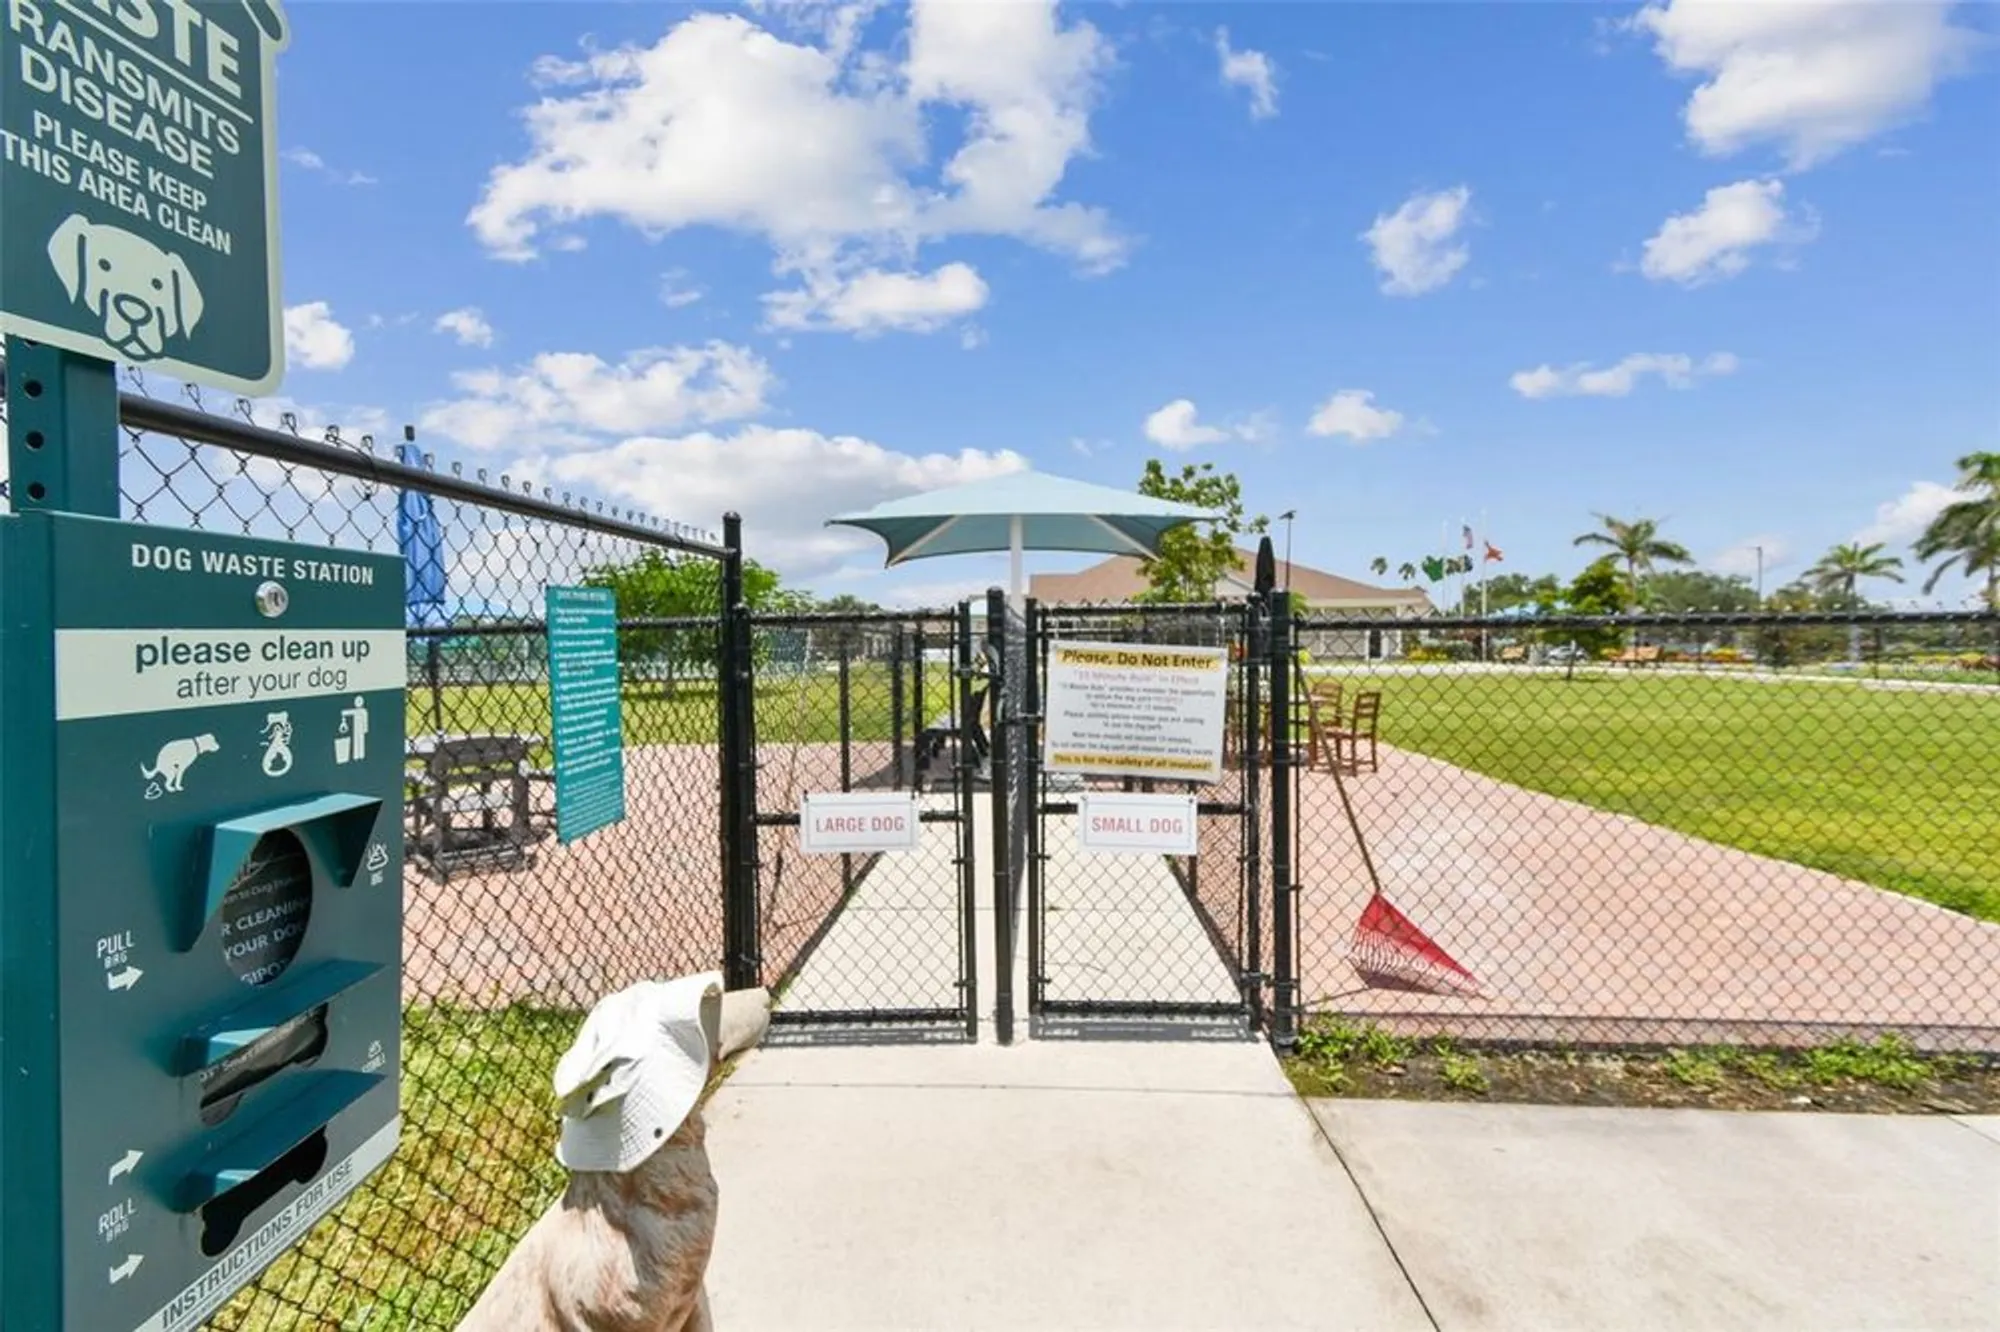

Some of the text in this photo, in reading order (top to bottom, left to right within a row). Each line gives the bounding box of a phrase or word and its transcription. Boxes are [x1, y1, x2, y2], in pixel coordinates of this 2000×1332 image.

[20, 43, 214, 179] DISEASE
[33, 110, 207, 212] PLEASE KEEP
[0, 129, 231, 255] THIS AREA CLEAN
[131, 544, 373, 585] DOG WASTE STATION
[136, 636, 370, 673] please clean up
[1118, 652, 1138, 665] Do
[1143, 654, 1171, 667] Not
[1174, 655, 1211, 669] Enter
[176, 666, 347, 699] after your dog
[815, 815, 905, 833] LARGE DOG
[1091, 816, 1183, 834] SMALL DOG
[97, 930, 136, 959] PULL
[223, 922, 302, 961] YOUR DO
[98, 1197, 137, 1236] ROLL
[162, 1160, 354, 1328] INSTRUCTIONS FOR USE
